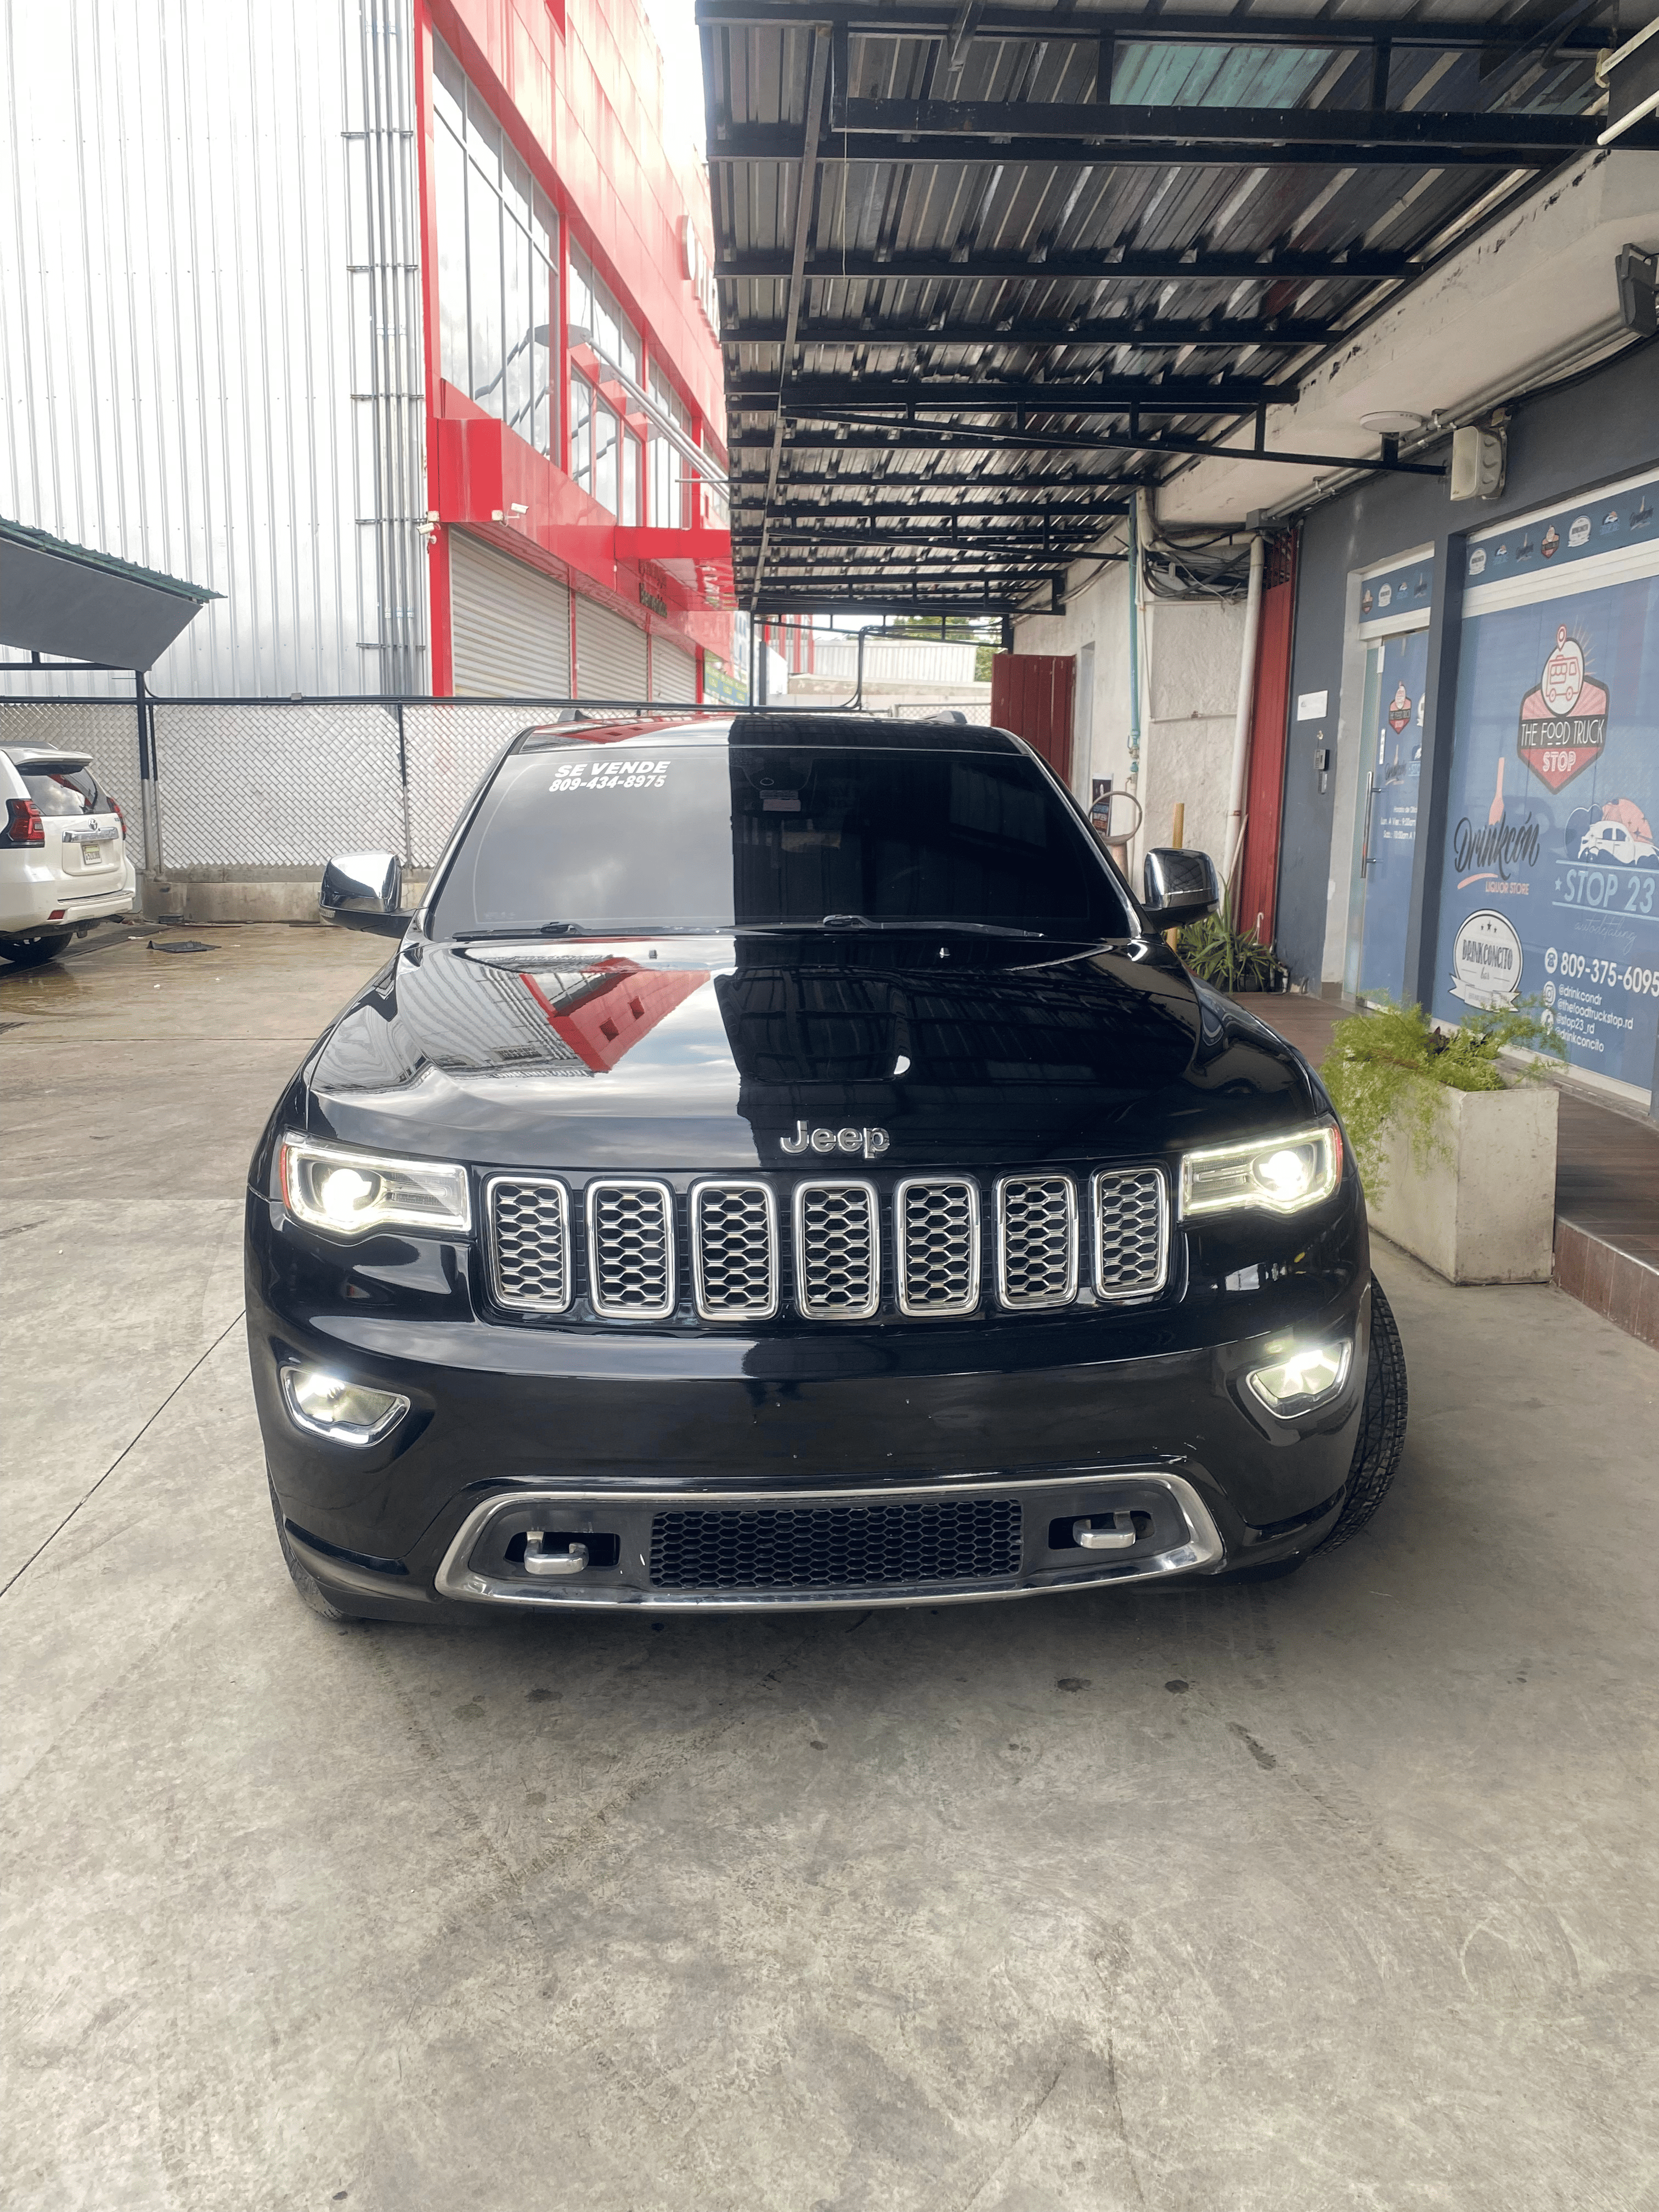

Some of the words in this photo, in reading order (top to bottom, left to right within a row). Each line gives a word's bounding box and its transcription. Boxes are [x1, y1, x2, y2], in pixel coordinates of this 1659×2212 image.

[1521, 723, 1538, 746] THE
[1540, 721, 1571, 746] FOOD
[1573, 719, 1605, 744] TRUCK
[555, 764, 588, 777] SE
[591, 761, 671, 775] VENDE
[1542, 751, 1576, 772] STOP
[549, 775, 667, 792] 809-434-8975
[1485, 881, 1509, 893] LIQUOR
[1510, 882, 1530, 895] STORE
[1564, 868, 1618, 907] STOP
[1624, 876, 1655, 913] 23
[1560, 952, 1659, 997] 809-375-6095
[1559, 984, 1602, 1005] @drinkcondr
[1556, 1013, 1595, 1034] @stop23_rd
[1557, 998, 1634, 1029] @thefoodtruckstop.rd
[780, 1120, 890, 1159] Jeep
